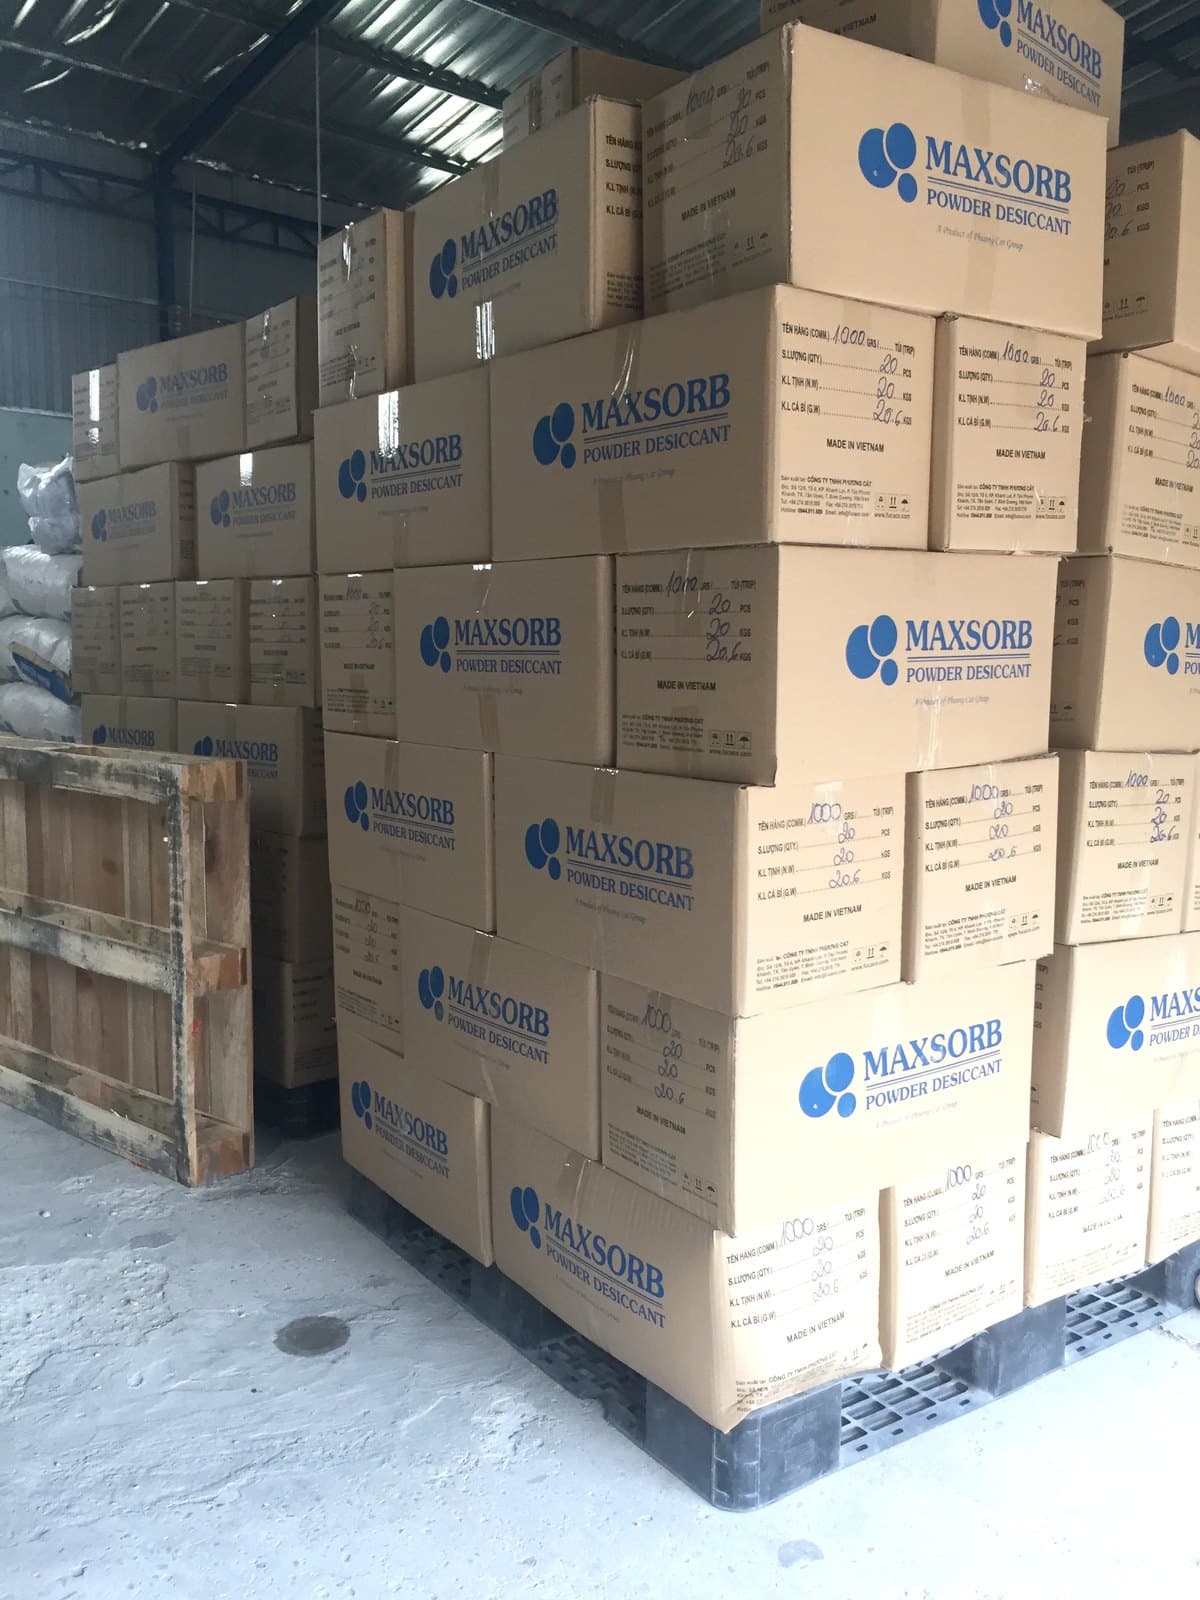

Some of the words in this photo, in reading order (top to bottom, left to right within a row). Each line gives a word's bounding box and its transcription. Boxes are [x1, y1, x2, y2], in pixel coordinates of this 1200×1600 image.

[1017, 0, 1102, 80] MAXSORB
[1017, 39, 1056, 78] POWDER
[1057, 68, 1101, 108] DESICCANT
[925, 135, 1072, 204] MAXSORB
[681, 206, 700, 222] MADE
[708, 188, 737, 212] VIETNAM
[927, 188, 991, 218] POWDER
[995, 204, 1072, 236] DESICCANT
[459, 187, 558, 264] MAXSORB
[461, 262, 501, 291] POWDER
[502, 233, 559, 274] DESICCANT
[159, 362, 229, 393] MAXSORB
[879, 353, 898, 375] 20
[903, 368, 912, 378] PCS
[1039, 367, 1056, 389] 20
[876, 375, 895, 400] 20
[1037, 388, 1055, 408] 20
[581, 373, 731, 434] MAXSORB
[369, 433, 463, 475] MAXSORB
[583, 440, 642, 465] POWDER
[646, 424, 732, 455] DESICCANT
[826, 438, 847, 449] MADE
[848, 440, 855, 450] IN
[856, 441, 885, 453] VIETNAM
[996, 448, 1014, 459] MADE
[1014, 449, 1021, 459] IN
[1021, 449, 1046, 461] VIETNAM
[231, 482, 297, 509] MAXSORB
[371, 482, 409, 500] POWDER
[410, 473, 464, 495] DESICCANT
[708, 592, 731, 615] 20
[740, 604, 751, 614] PCS
[453, 617, 562, 647] MAXSORB
[706, 618, 731, 640] 20
[905, 619, 1033, 652] MAXSORB
[455, 659, 498, 674] POWDER
[501, 659, 563, 675] DESICCANT
[906, 667, 963, 684] POWDER
[966, 663, 1032, 681] DESICCANT
[656, 680, 677, 691] MADE
[677, 681, 685, 691] IN
[686, 681, 717, 692] VIETNAM
[107, 726, 155, 747] MAXSORB
[214, 739, 279, 763] MAXSORB
[370, 786, 455, 826] MAXSORB
[1155, 788, 1171, 805] 20
[372, 820, 407, 840] POWDER
[408, 828, 456, 851] DESICCANT
[565, 825, 695, 880] MAXSORB
[833, 846, 855, 866] 20
[1117, 861, 1133, 870] MADE
[567, 868, 617, 894] POWDER
[619, 880, 696, 912] DESICCANT
[965, 882, 984, 893] MADE
[984, 880, 991, 890] IN
[991, 874, 1017, 888] VIETNAM
[803, 910, 824, 923] MADE
[824, 908, 832, 920] IN
[833, 904, 863, 918] VIETNAM
[447, 975, 550, 1037] MAXSORB
[447, 1012, 487, 1042] POWDER
[488, 1030, 550, 1065] DESICCANT
[863, 1018, 1003, 1082] MAXSORB
[1149, 1025, 1191, 1047] POWDER
[865, 1081, 929, 1111] POWDER
[932, 1057, 1004, 1093] DESICCANT
[373, 1090, 449, 1156] MAXSORB
[660, 1116, 686, 1136] VIETNAM
[544, 1200, 665, 1299] MAXSORB
[944, 1264, 964, 1277] MADE
[971, 1250, 996, 1267] VIETNAM
[545, 1243, 592, 1286] POWDER
[593, 1276, 666, 1329] DESICCANT
[787, 1328, 808, 1344] MADE
[808, 1324, 817, 1335] IN
[817, 1311, 846, 1331] VIETNAM
